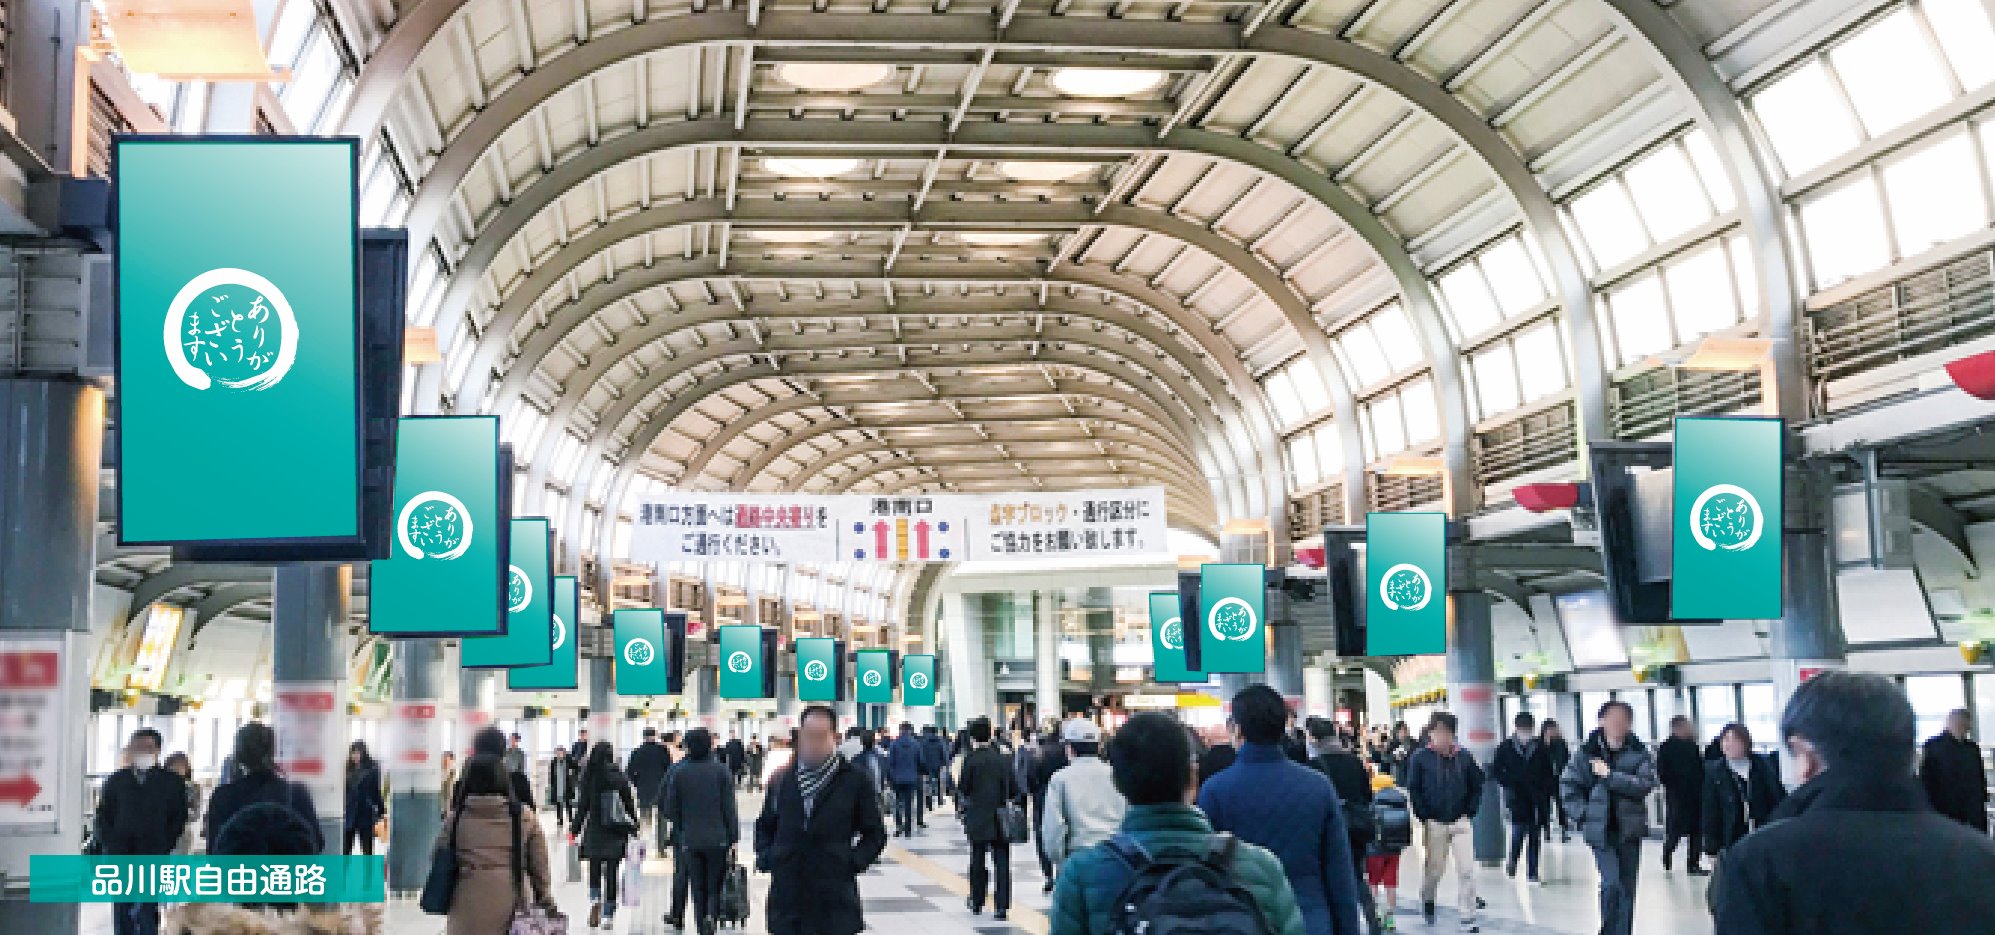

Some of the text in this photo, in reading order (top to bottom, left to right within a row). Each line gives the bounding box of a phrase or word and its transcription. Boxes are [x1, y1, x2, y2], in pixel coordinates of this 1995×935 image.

[183, 311, 206, 362] ます
[204, 294, 231, 367] ござい
[230, 309, 245, 363] とう
[246, 295, 275, 371] ありが
